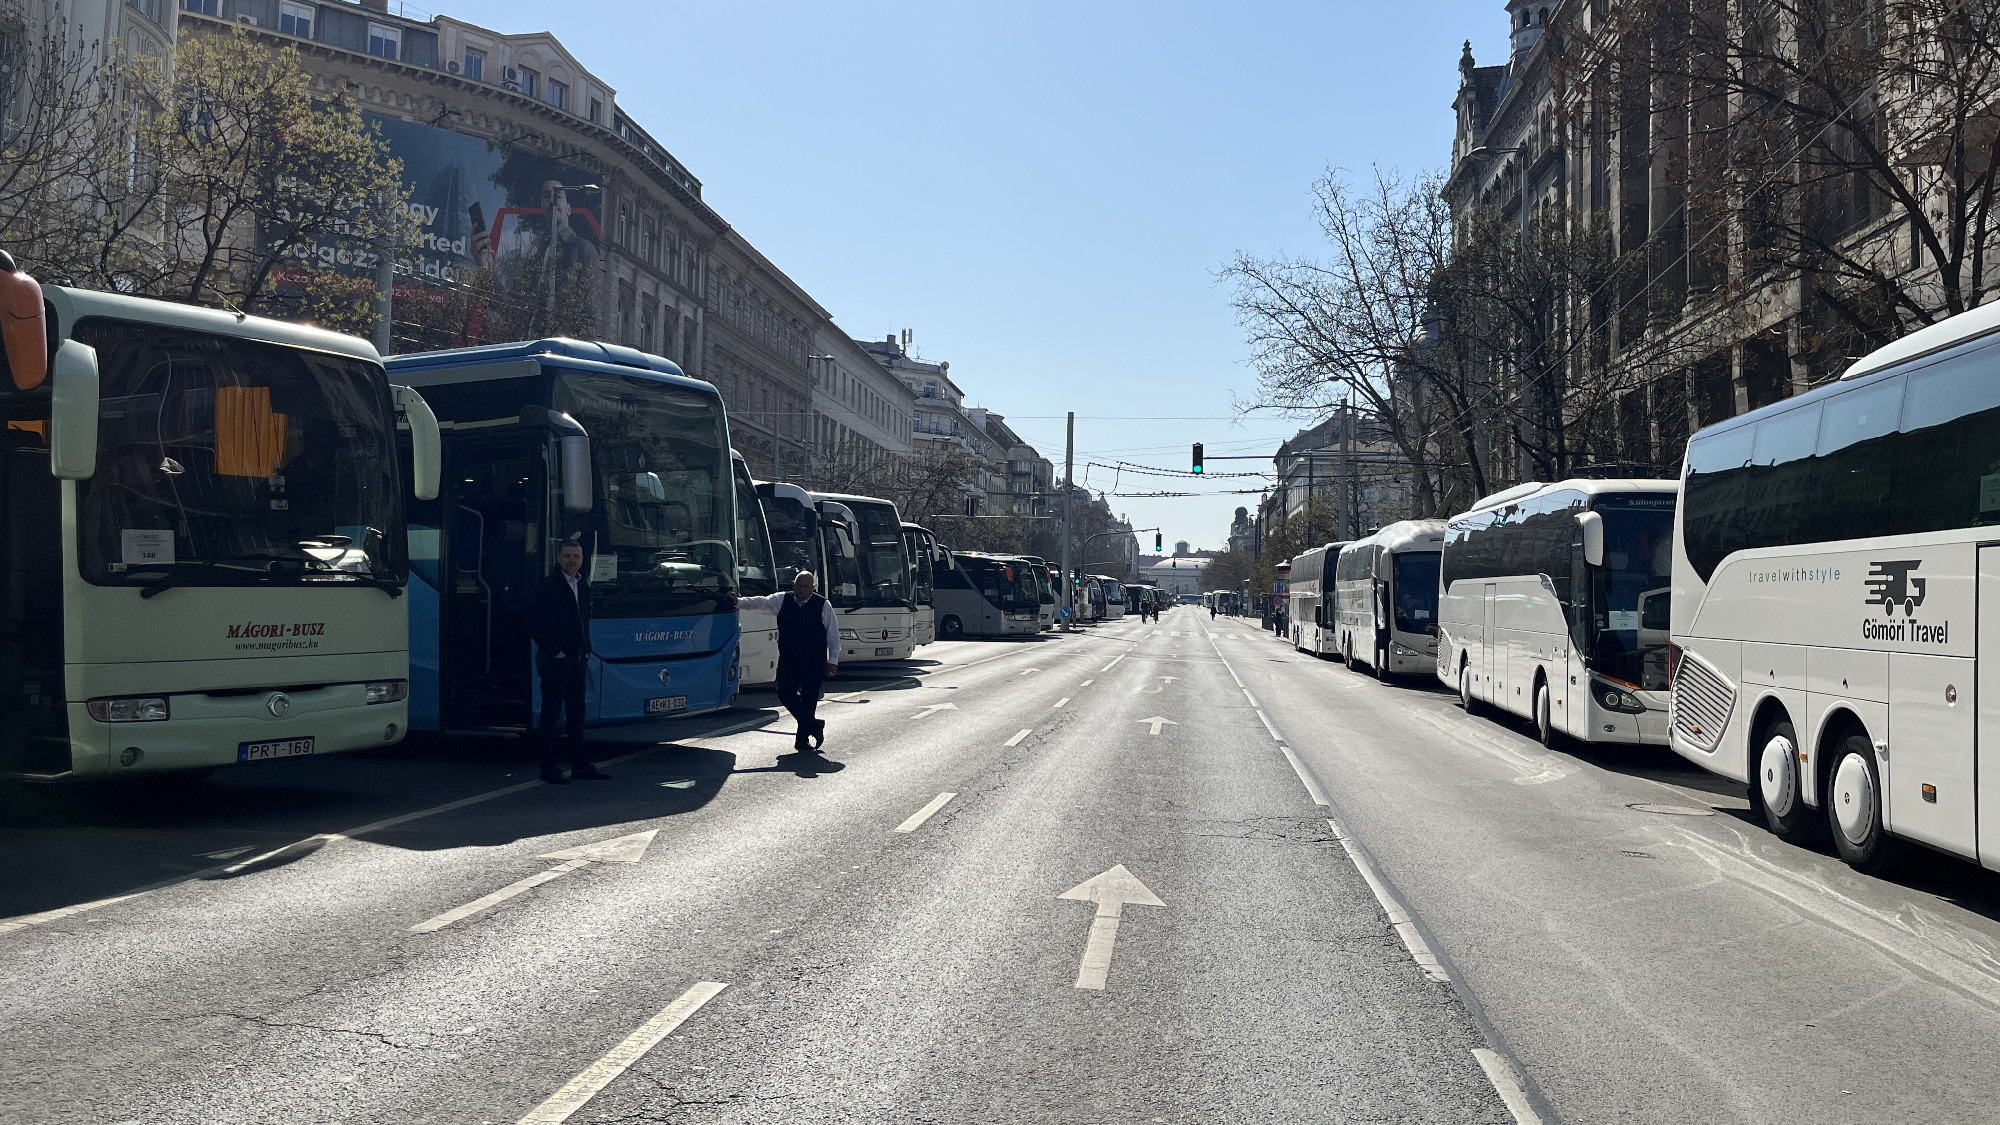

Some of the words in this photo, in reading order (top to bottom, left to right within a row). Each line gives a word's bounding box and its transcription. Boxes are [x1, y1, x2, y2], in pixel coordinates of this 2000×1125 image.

[226, 620, 325, 639] MÁGORI-BUSZ
[634, 629, 694, 642] MÁGORI-BUSZ
[1862, 618, 1905, 642] Gömöri
[1908, 618, 1949, 644] Travel
[250, 740, 311, 759] PRT-169
